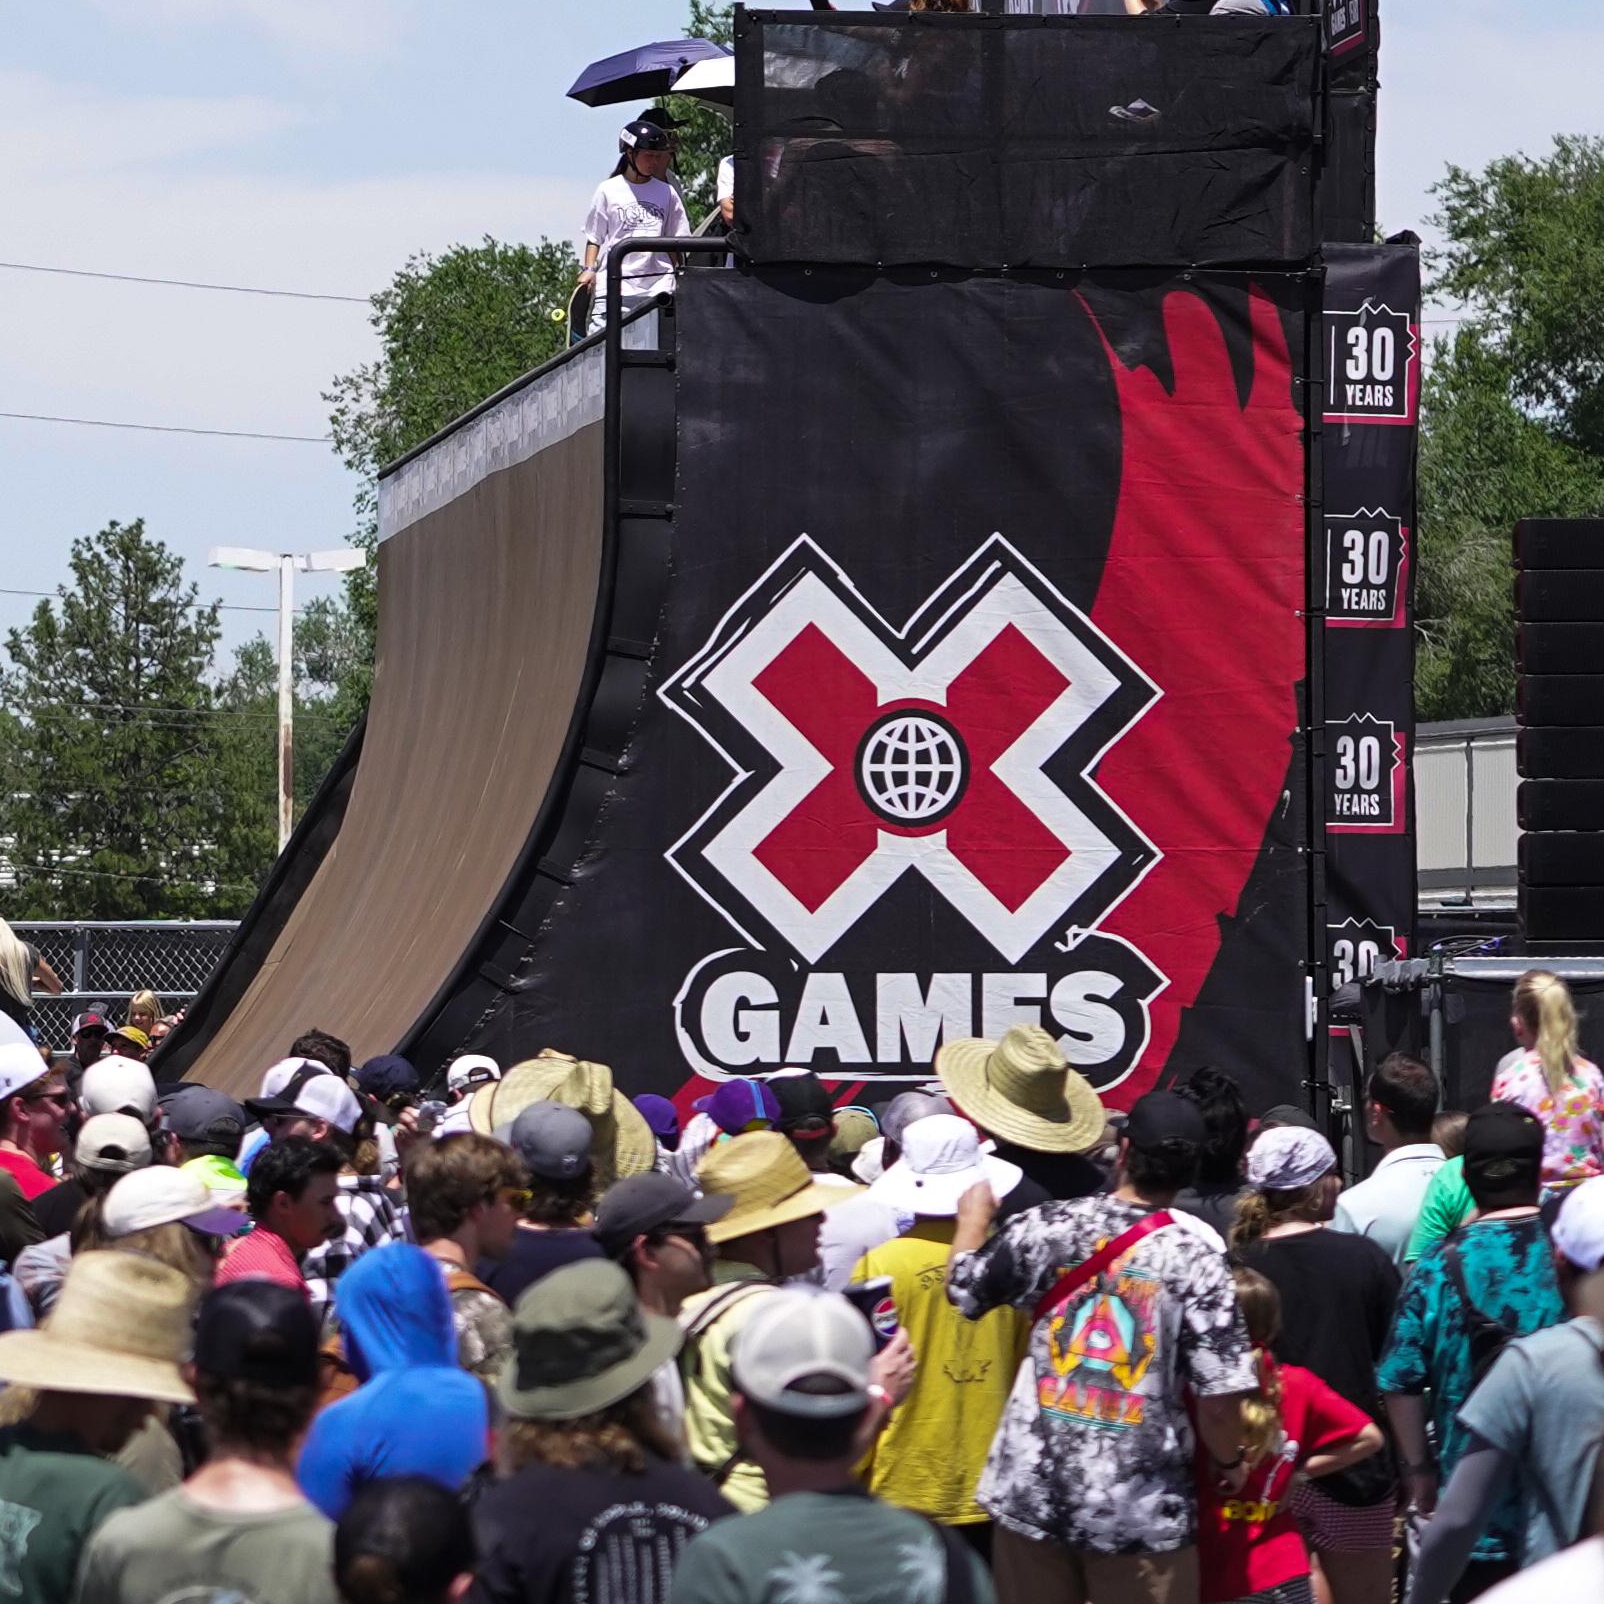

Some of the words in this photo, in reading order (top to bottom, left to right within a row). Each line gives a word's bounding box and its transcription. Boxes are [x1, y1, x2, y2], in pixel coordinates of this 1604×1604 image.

[1345, 326, 1395, 381] 30
[1345, 383, 1394, 408] YEARS
[1341, 528, 1390, 585] 30
[1341, 587, 1386, 611] YEARS
[1334, 735, 1381, 790] 30
[1333, 792, 1381, 816] YEARS
[1332, 939, 1380, 990] 30
